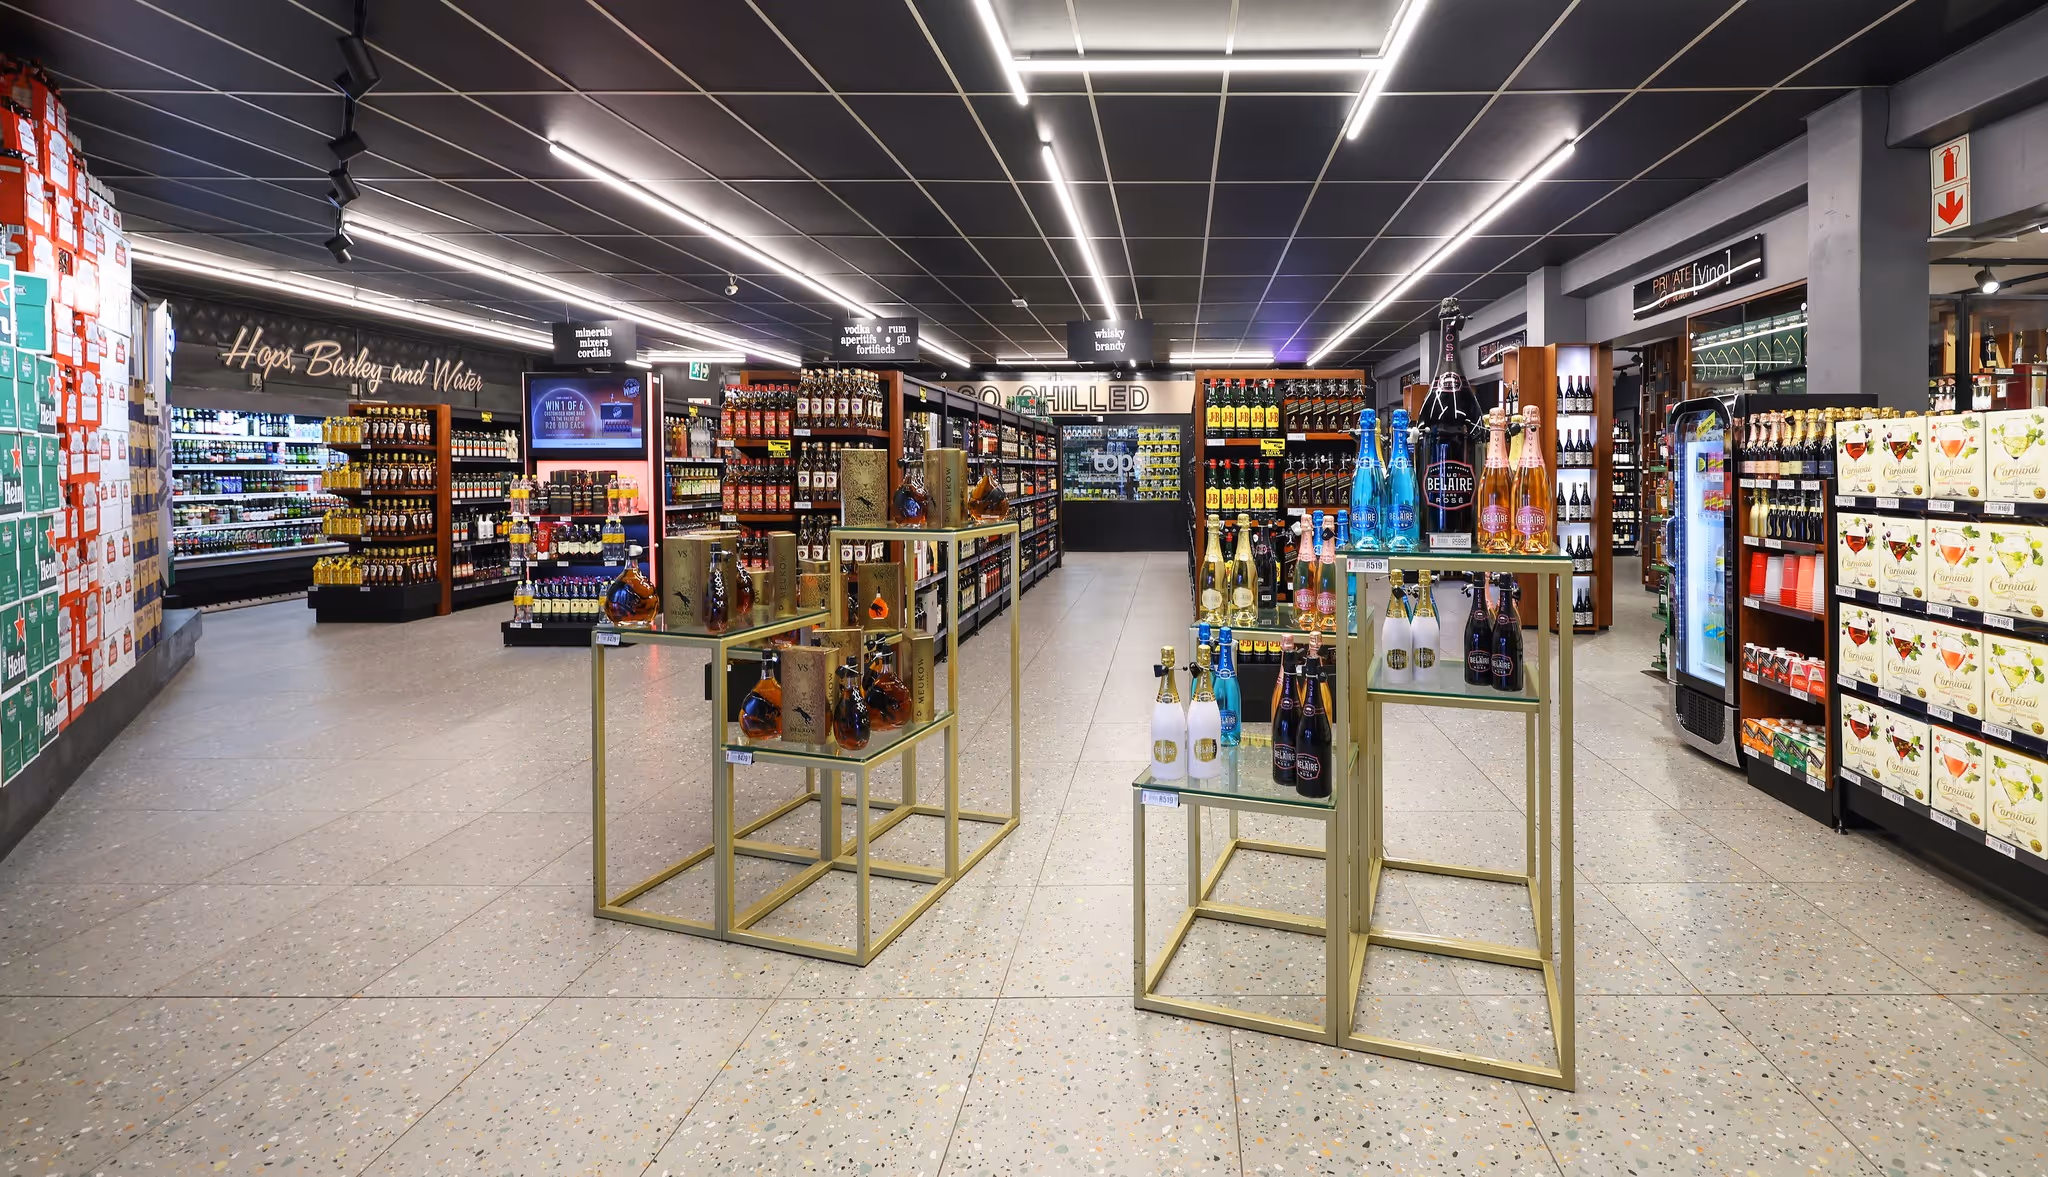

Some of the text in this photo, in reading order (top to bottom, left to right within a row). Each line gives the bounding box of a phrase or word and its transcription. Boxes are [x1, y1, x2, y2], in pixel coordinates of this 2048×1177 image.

[1653, 266, 1691, 294] PRIVATE
[575, 327, 612, 337] minerals
[844, 324, 870, 334] vodka
[1095, 328, 1125, 340] whisky
[580, 338, 608, 347] mixers
[841, 334, 910, 346] aperitifs gin
[1095, 341, 1126, 352] brandy
[578, 348, 611, 358] cordials
[856, 344, 895, 354] fortifieds
[221, 325, 484, 394] Hops, Barley and Water
[545, 401, 560, 411] WIN
[567, 401, 577, 410] OF
[579, 401, 584, 410] 6
[1841, 463, 1872, 478] Carnival
[1883, 463, 1918, 479] Carnival
[1933, 463, 1973, 480] Carnival
[1993, 463, 2040, 480] Carnival
[1427, 477, 1472, 492] BELAIRE
[1352, 512, 1375, 521] BELAIRE
[1389, 512, 1413, 520] BELAIRE
[1484, 514, 1508, 523] BELAIRE
[1518, 515, 1544, 524] BELAIRE
[678, 550, 688, 558] VS
[1366, 561, 1383, 570] R519
[1841, 555, 1872, 570] Carnival
[1884, 563, 1917, 579] Carnival
[1933, 568, 1974, 585] Carnival
[1990, 575, 2037, 594] Carnival
[1843, 647, 1874, 662] Carnival
[797, 664, 809, 672] VS
[1887, 660, 1921, 676] Carnival
[1934, 671, 1972, 690] Carnival
[1991, 688, 2038, 708] Carnival
[1274, 750, 1295, 760] BELAIRE
[1846, 739, 1876, 757] Carnival
[1297, 760, 1318, 771] BELAIRE
[1886, 756, 1920, 777] Carnival
[1937, 777, 1975, 800] Carnival
[1992, 801, 2037, 825] Carnival
